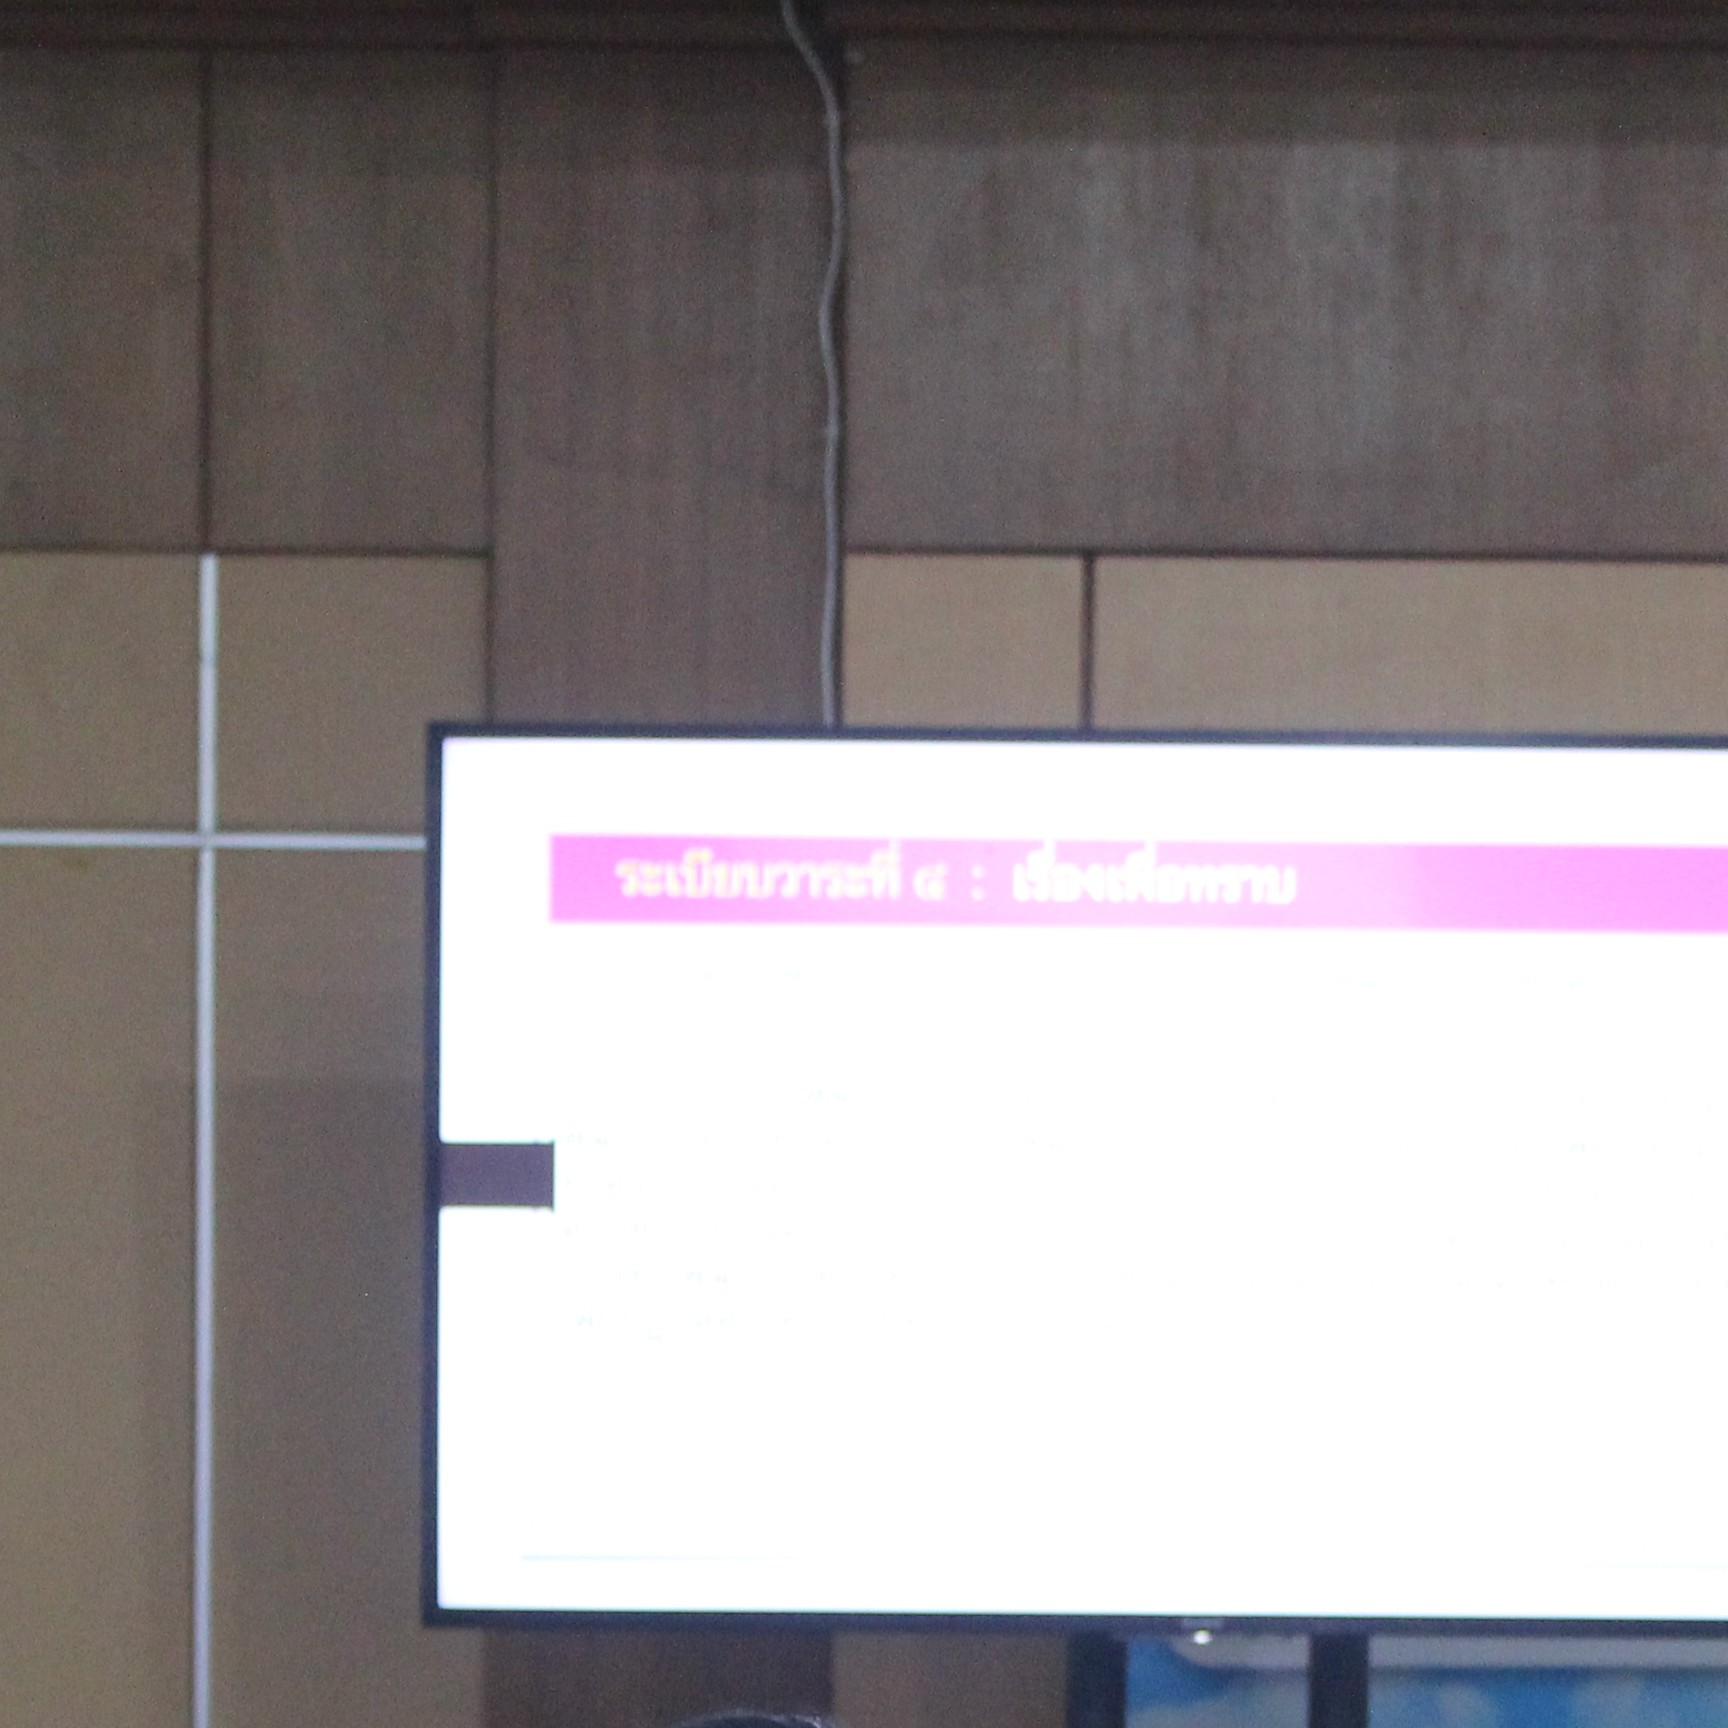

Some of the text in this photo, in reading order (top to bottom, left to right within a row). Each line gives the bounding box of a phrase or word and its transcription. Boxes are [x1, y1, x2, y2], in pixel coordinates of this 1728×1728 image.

[614, 841, 900, 900] ระเบียบวาระที่
